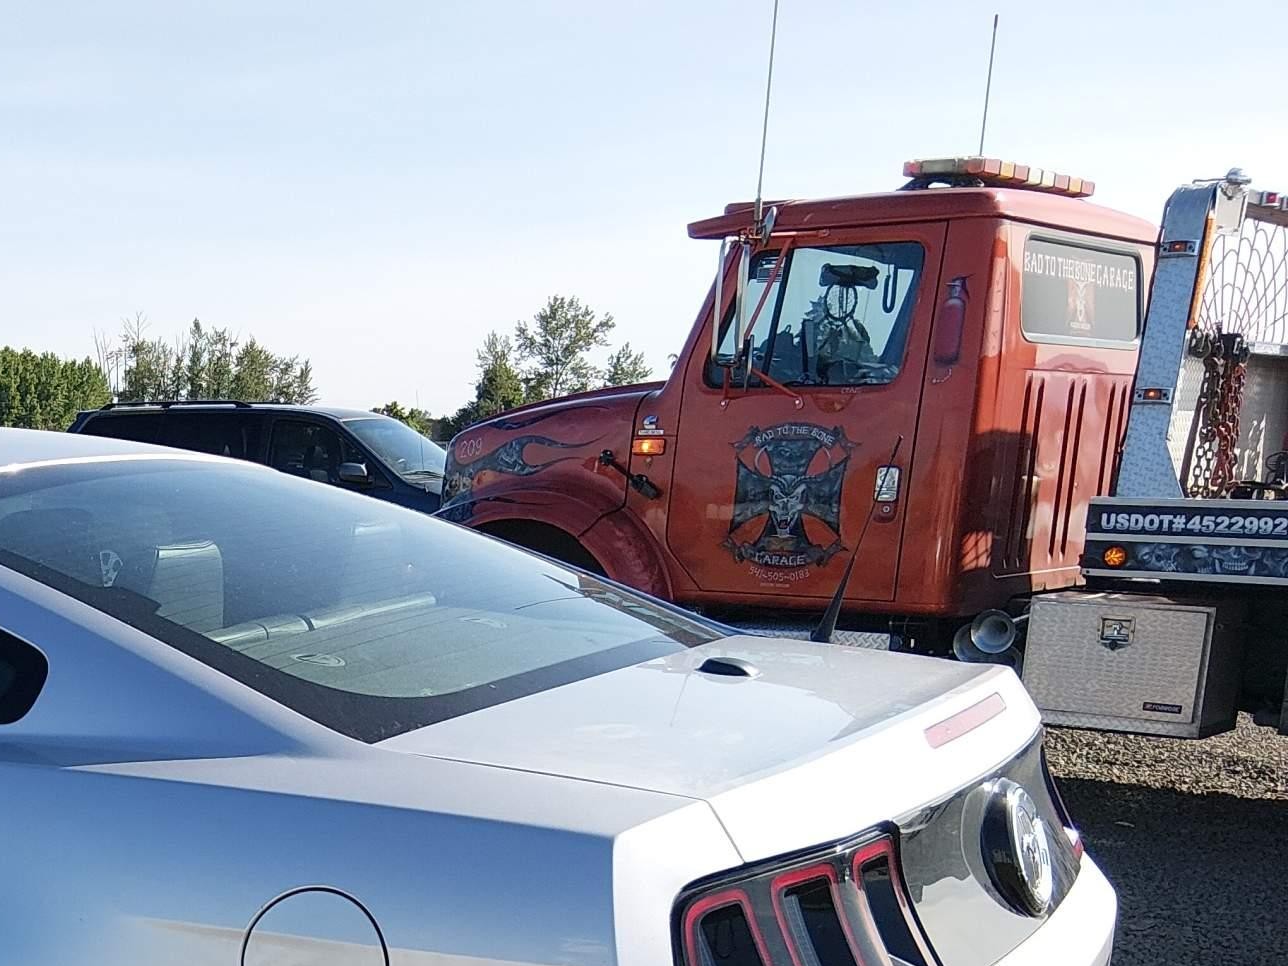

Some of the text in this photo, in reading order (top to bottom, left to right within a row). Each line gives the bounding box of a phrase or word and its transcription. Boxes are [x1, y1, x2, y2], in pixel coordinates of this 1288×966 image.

[1024, 252, 1044, 273] BAD
[1045, 255, 1056, 276] TO
[1096, 264, 1134, 292] GARAGE
[754, 425, 835, 446] BAD TO THE BONE
[460, 438, 482, 458] 209
[1101, 513, 1288, 535] USDOT#4522992
[755, 554, 806, 566] GARAGE
